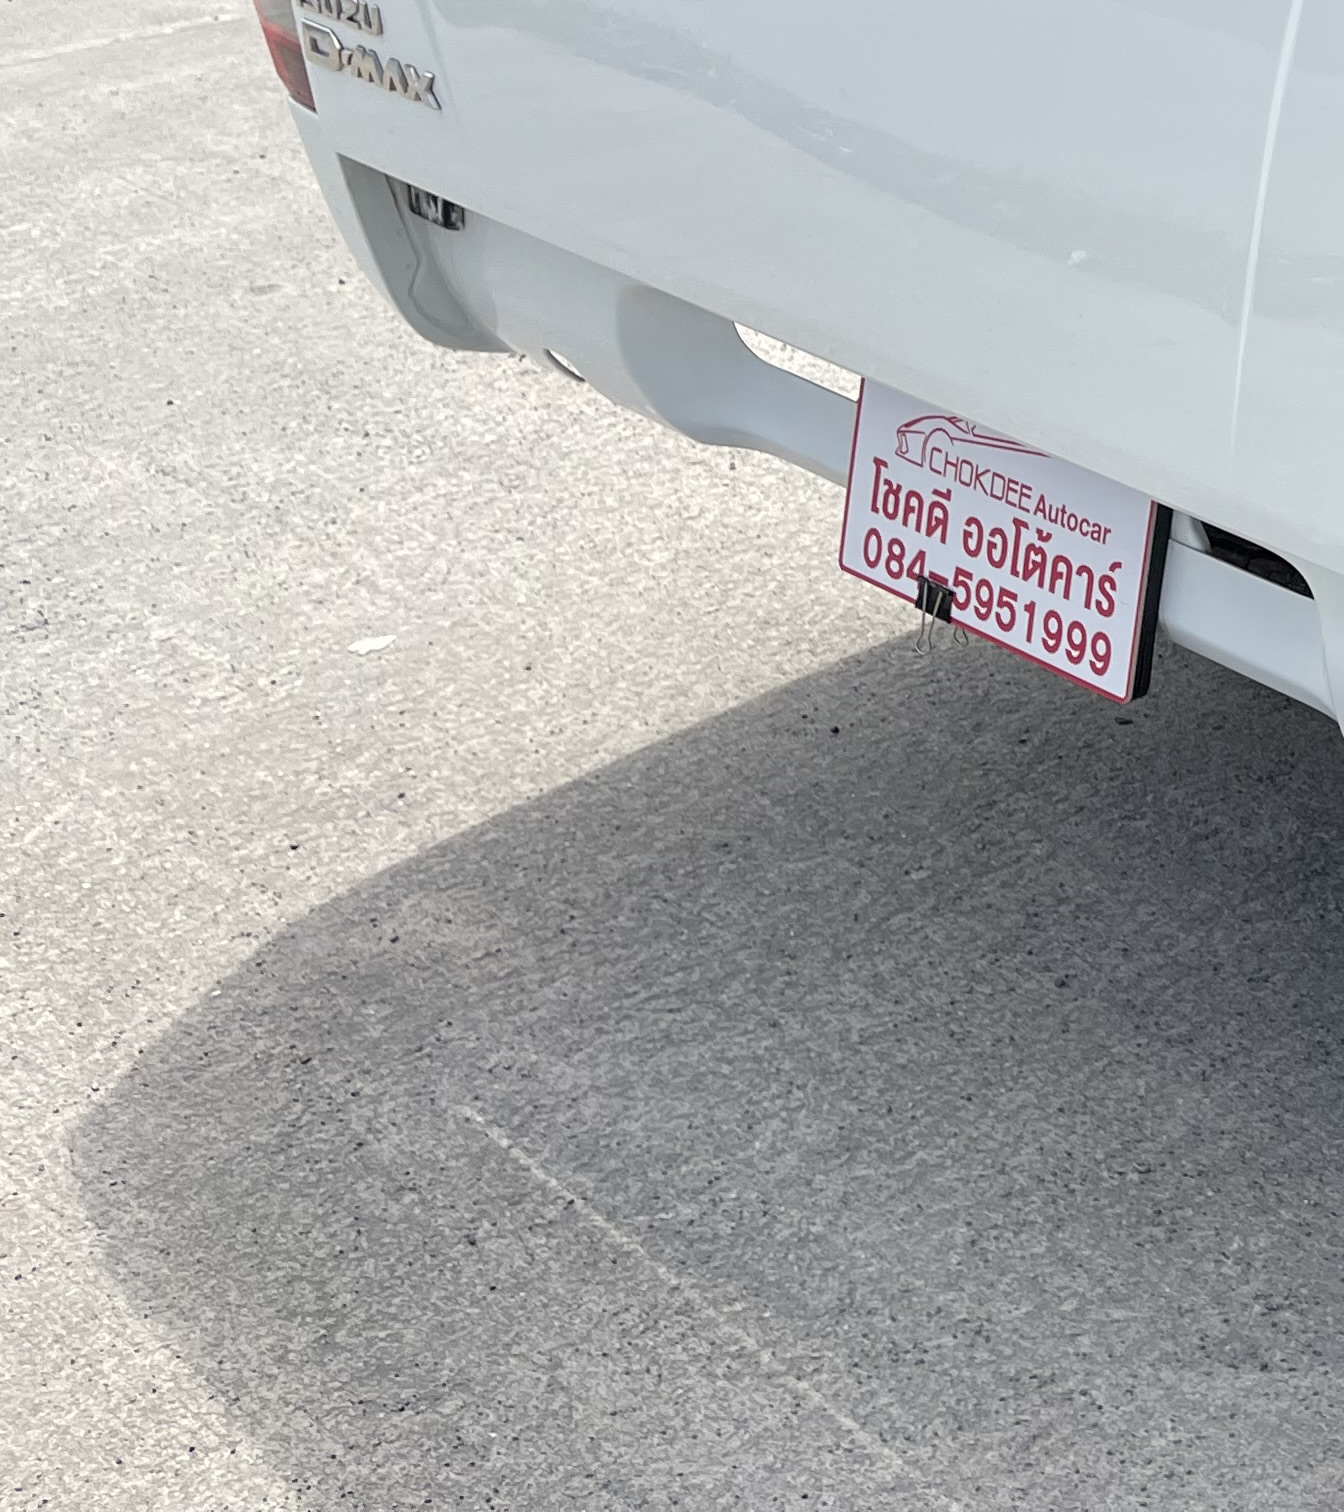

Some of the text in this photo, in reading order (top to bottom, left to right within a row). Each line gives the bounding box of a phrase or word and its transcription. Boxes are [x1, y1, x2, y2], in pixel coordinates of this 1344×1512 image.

[302, 16, 442, 111] D-MAX
[870, 455, 1123, 618] โชคดี ออโต้คาร์
[928, 446, 1112, 545] CHOKDEE Autocar
[862, 527, 1113, 677] 084-5951999
